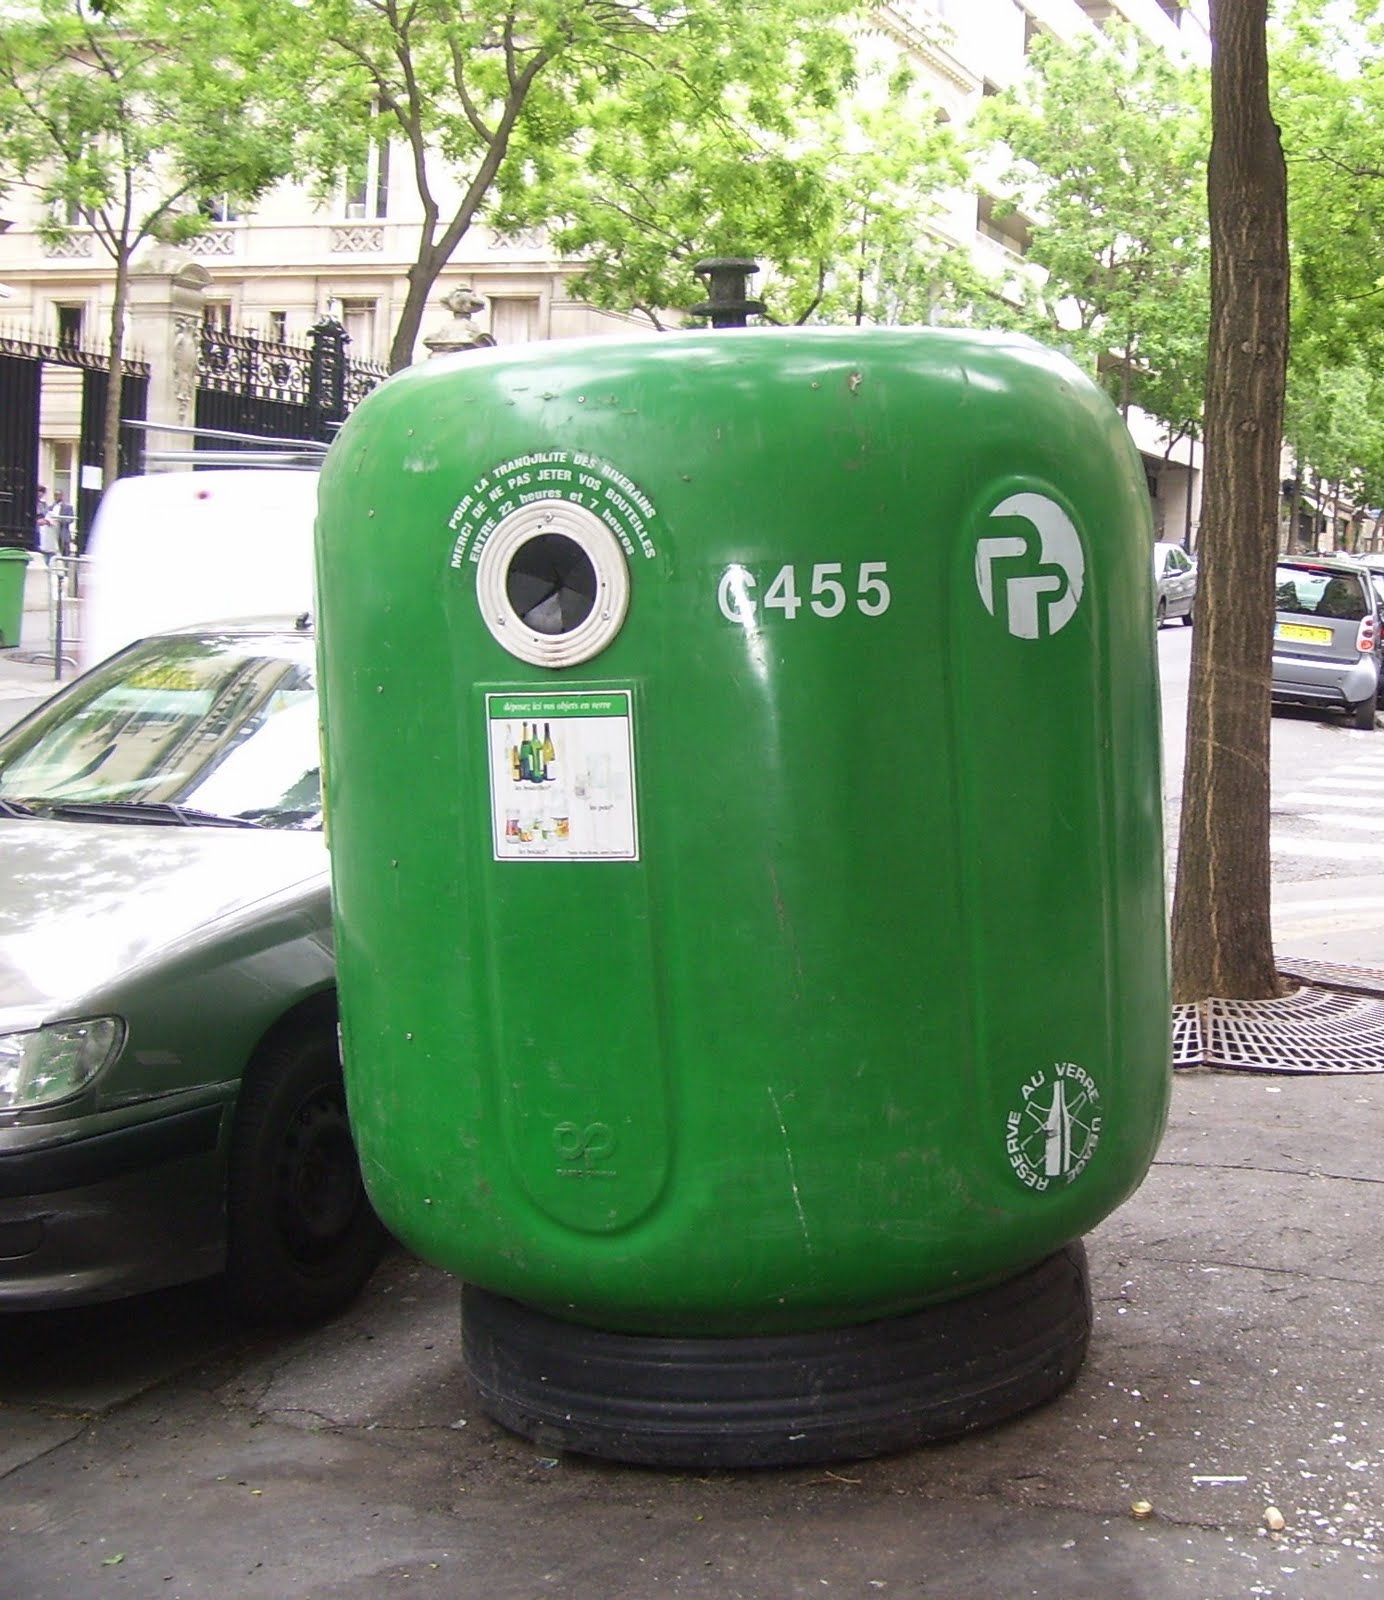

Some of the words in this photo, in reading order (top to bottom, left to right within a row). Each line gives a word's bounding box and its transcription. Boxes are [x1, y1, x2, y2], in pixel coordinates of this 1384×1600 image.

[449, 495, 473, 529] POUR
[474, 477, 489, 494] LA
[573, 454, 596, 469] DES
[600, 464, 656, 518] RIVERAINS
[451, 522, 473, 569] MERCI
[472, 501, 487, 520] DE
[489, 486, 506, 503] NE
[507, 472, 531, 490] PAS
[537, 469, 572, 482] JETER
[579, 473, 602, 491] VOS
[605, 487, 656, 559] BOUTEILLES
[469, 516, 498, 564] ENTRE
[498, 500, 516, 517] 22
[519, 488, 562, 504] heures
[569, 490, 583, 503] et
[589, 498, 599, 509] 7
[602, 509, 635, 556] heures
[718, 562, 891, 623] G455
[1021, 1070, 1045, 1100] AU
[1055, 1062, 1100, 1104] VERRE
[1006, 1111, 1049, 1191] RESERVE
